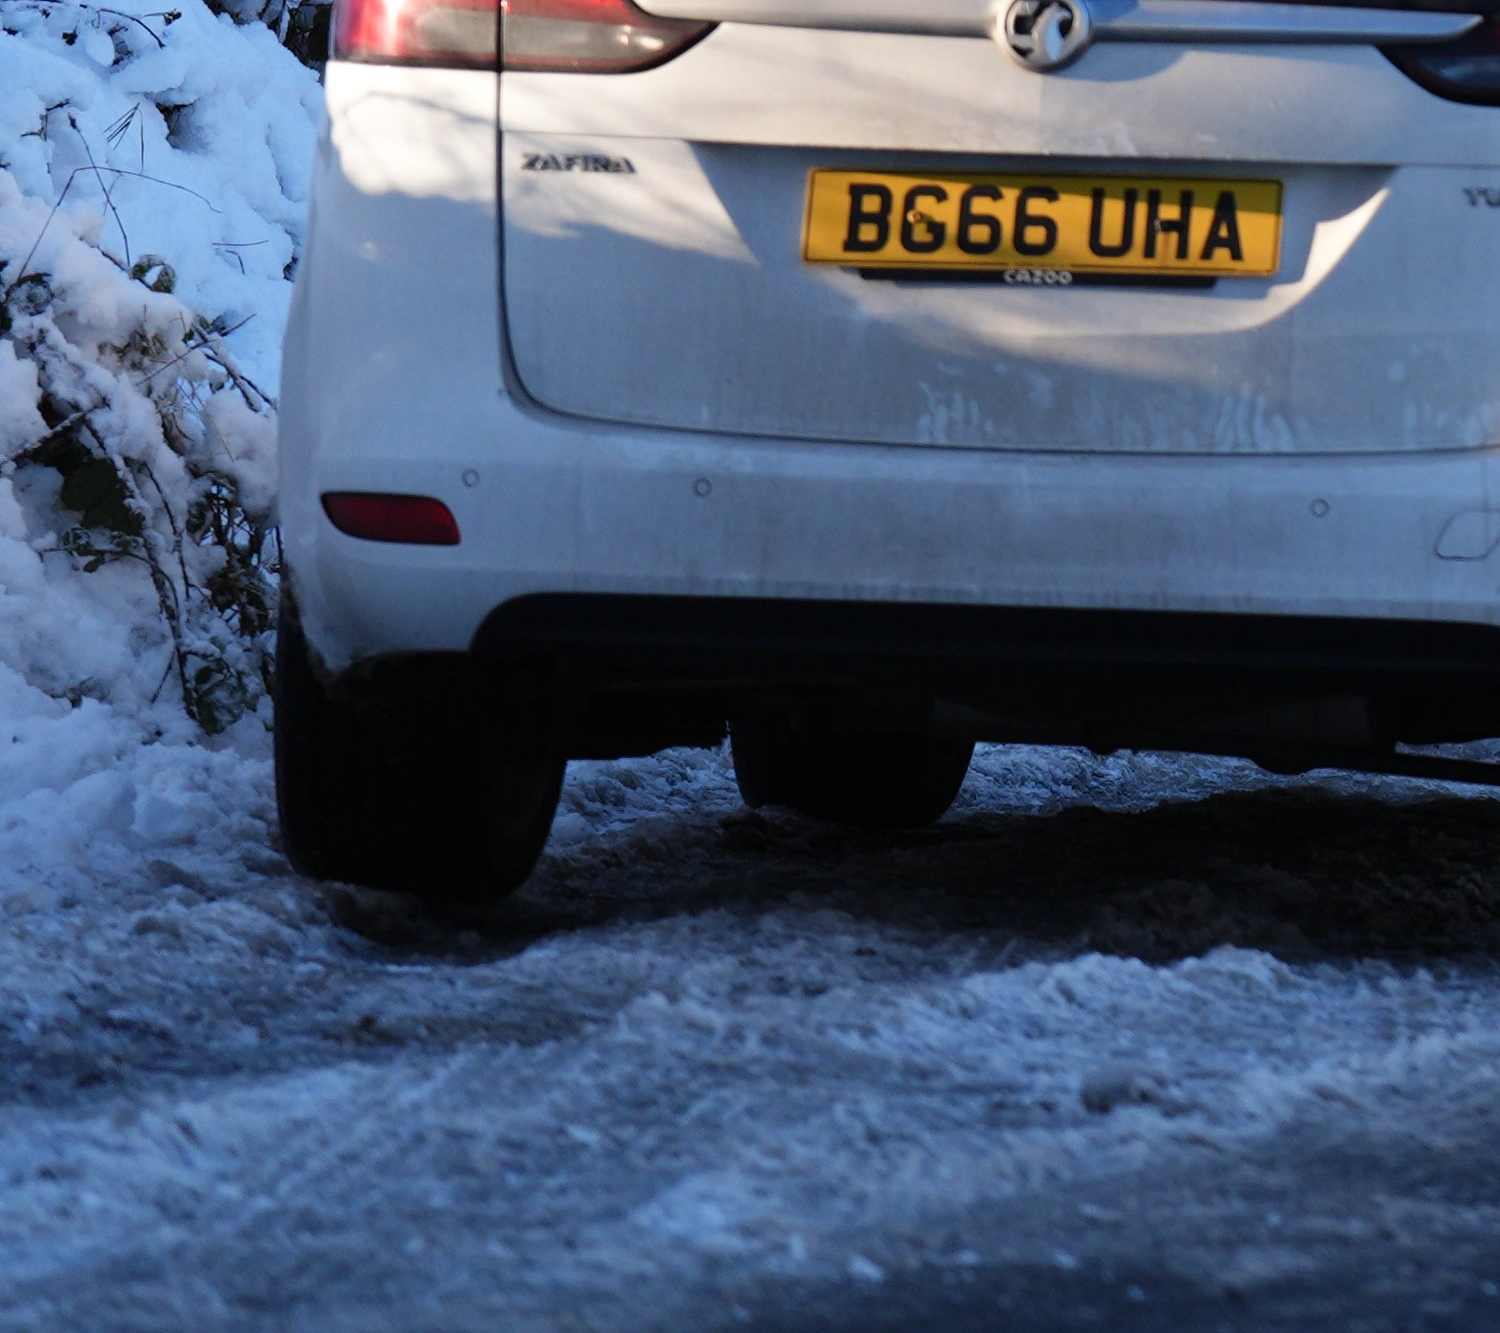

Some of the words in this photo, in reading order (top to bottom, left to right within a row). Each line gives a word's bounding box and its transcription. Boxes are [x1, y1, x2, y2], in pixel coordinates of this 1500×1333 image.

[520, 153, 638, 174] ZAFIRA
[843, 182, 1060, 256] BG66
[1087, 187, 1245, 262] UHA
